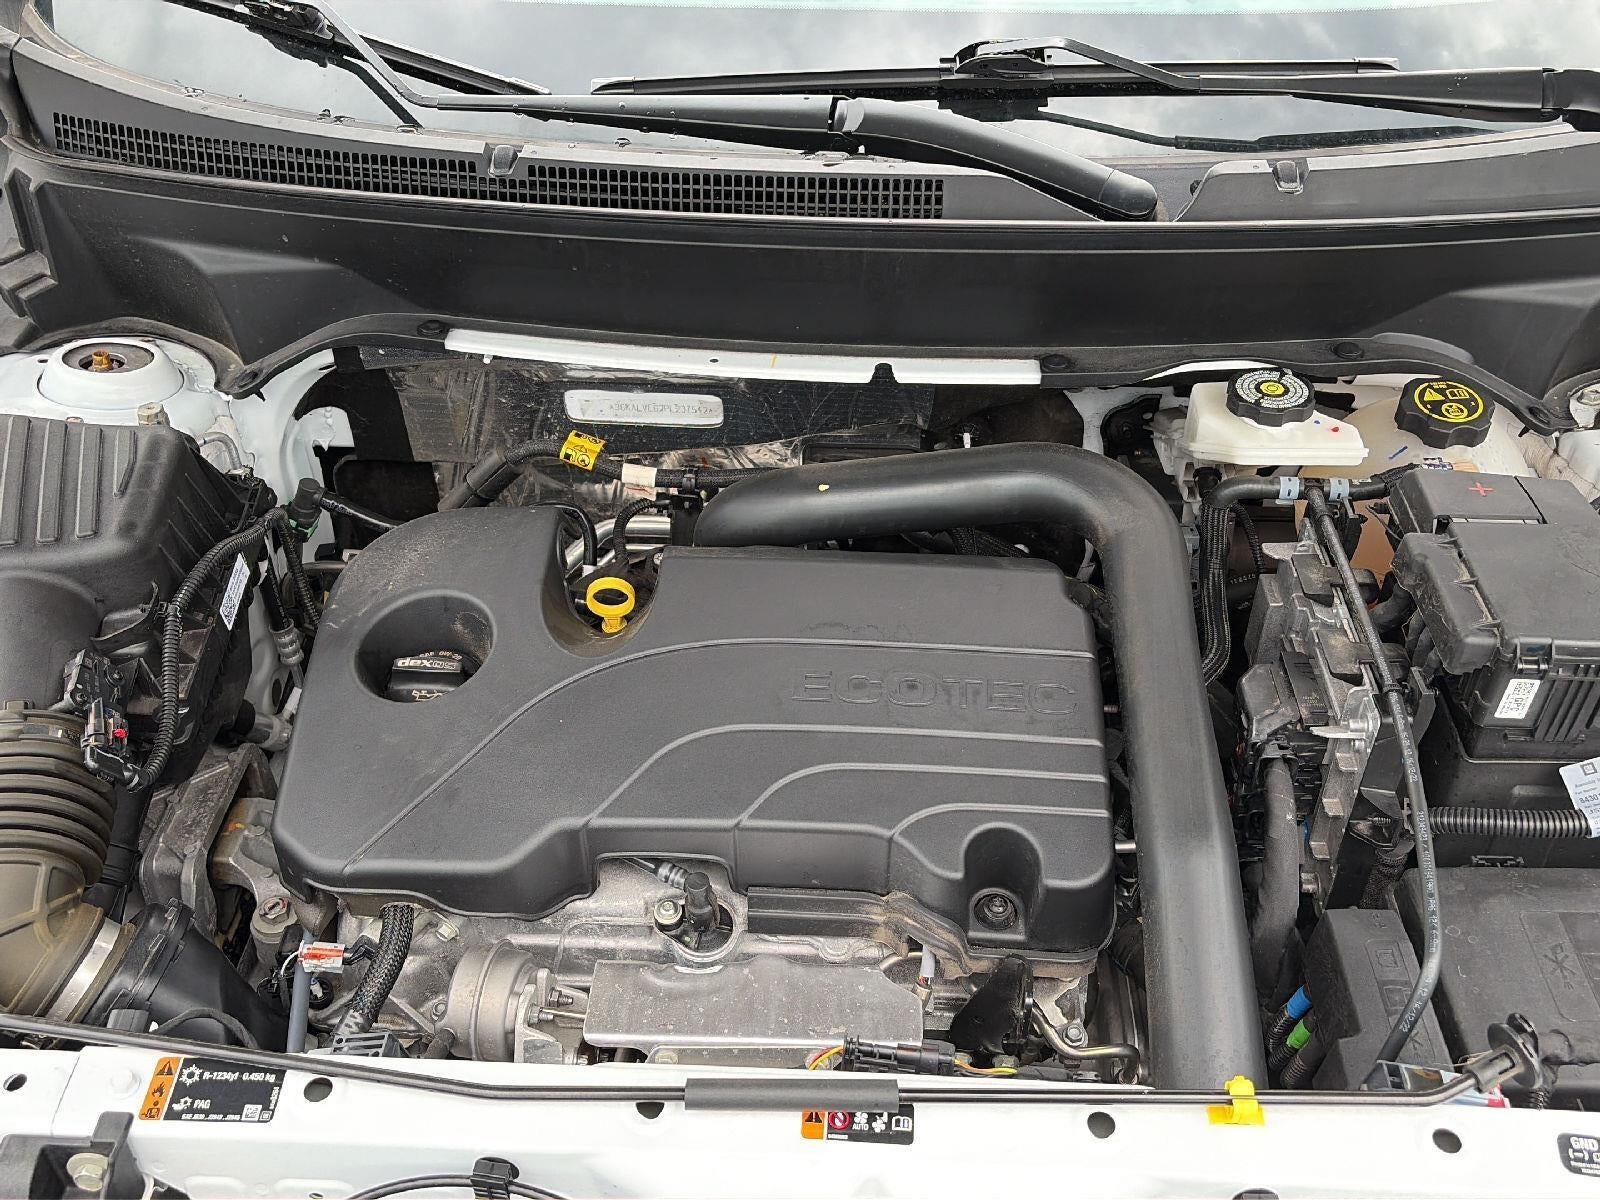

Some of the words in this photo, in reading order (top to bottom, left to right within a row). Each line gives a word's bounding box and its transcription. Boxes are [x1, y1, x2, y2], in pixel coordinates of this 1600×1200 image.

[792, 671, 1079, 715] ECOTEC
[1579, 793, 1600, 804] 8430
[202, 1071, 240, 1082] R-1234yf
[242, 1072, 265, 1082] 0.450
[265, 1072, 276, 1083] kg
[193, 1099, 211, 1109] PAG
[852, 1123, 869, 1131] AUTO
[1570, 1136, 1599, 1150] GND
